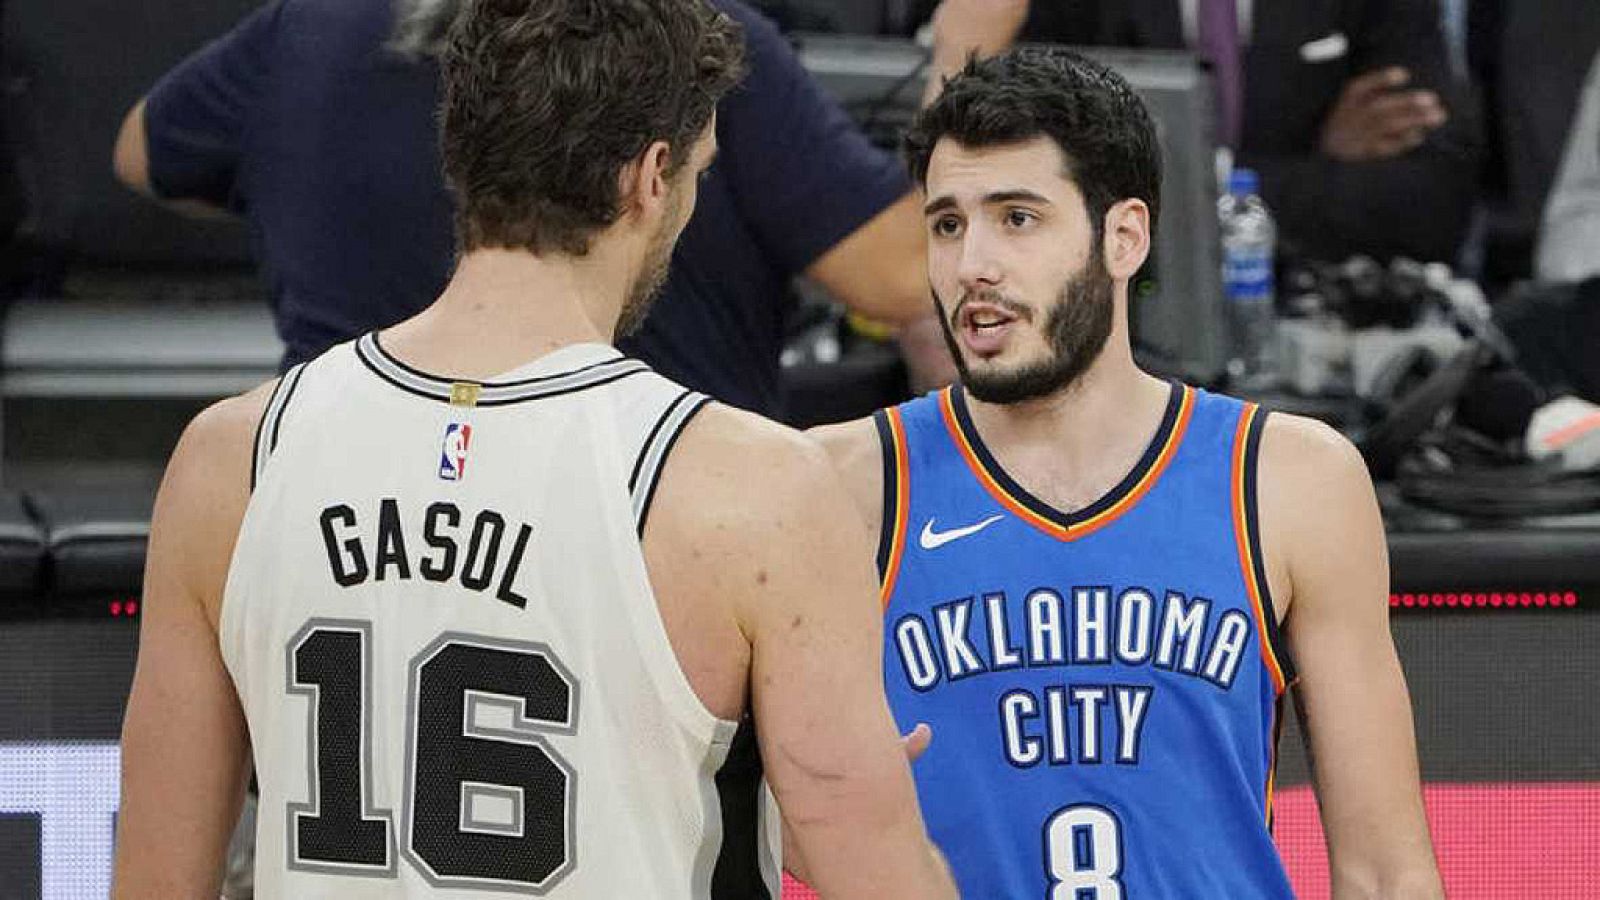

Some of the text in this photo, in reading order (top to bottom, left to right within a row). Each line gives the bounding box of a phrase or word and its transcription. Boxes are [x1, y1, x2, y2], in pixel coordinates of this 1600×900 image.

[320, 498, 533, 609] GASOL
[895, 586, 1251, 692] OKLAHOMA
[286, 617, 580, 895] 16
[1000, 685, 1154, 768] CITY
[1042, 803, 1126, 900] 8
